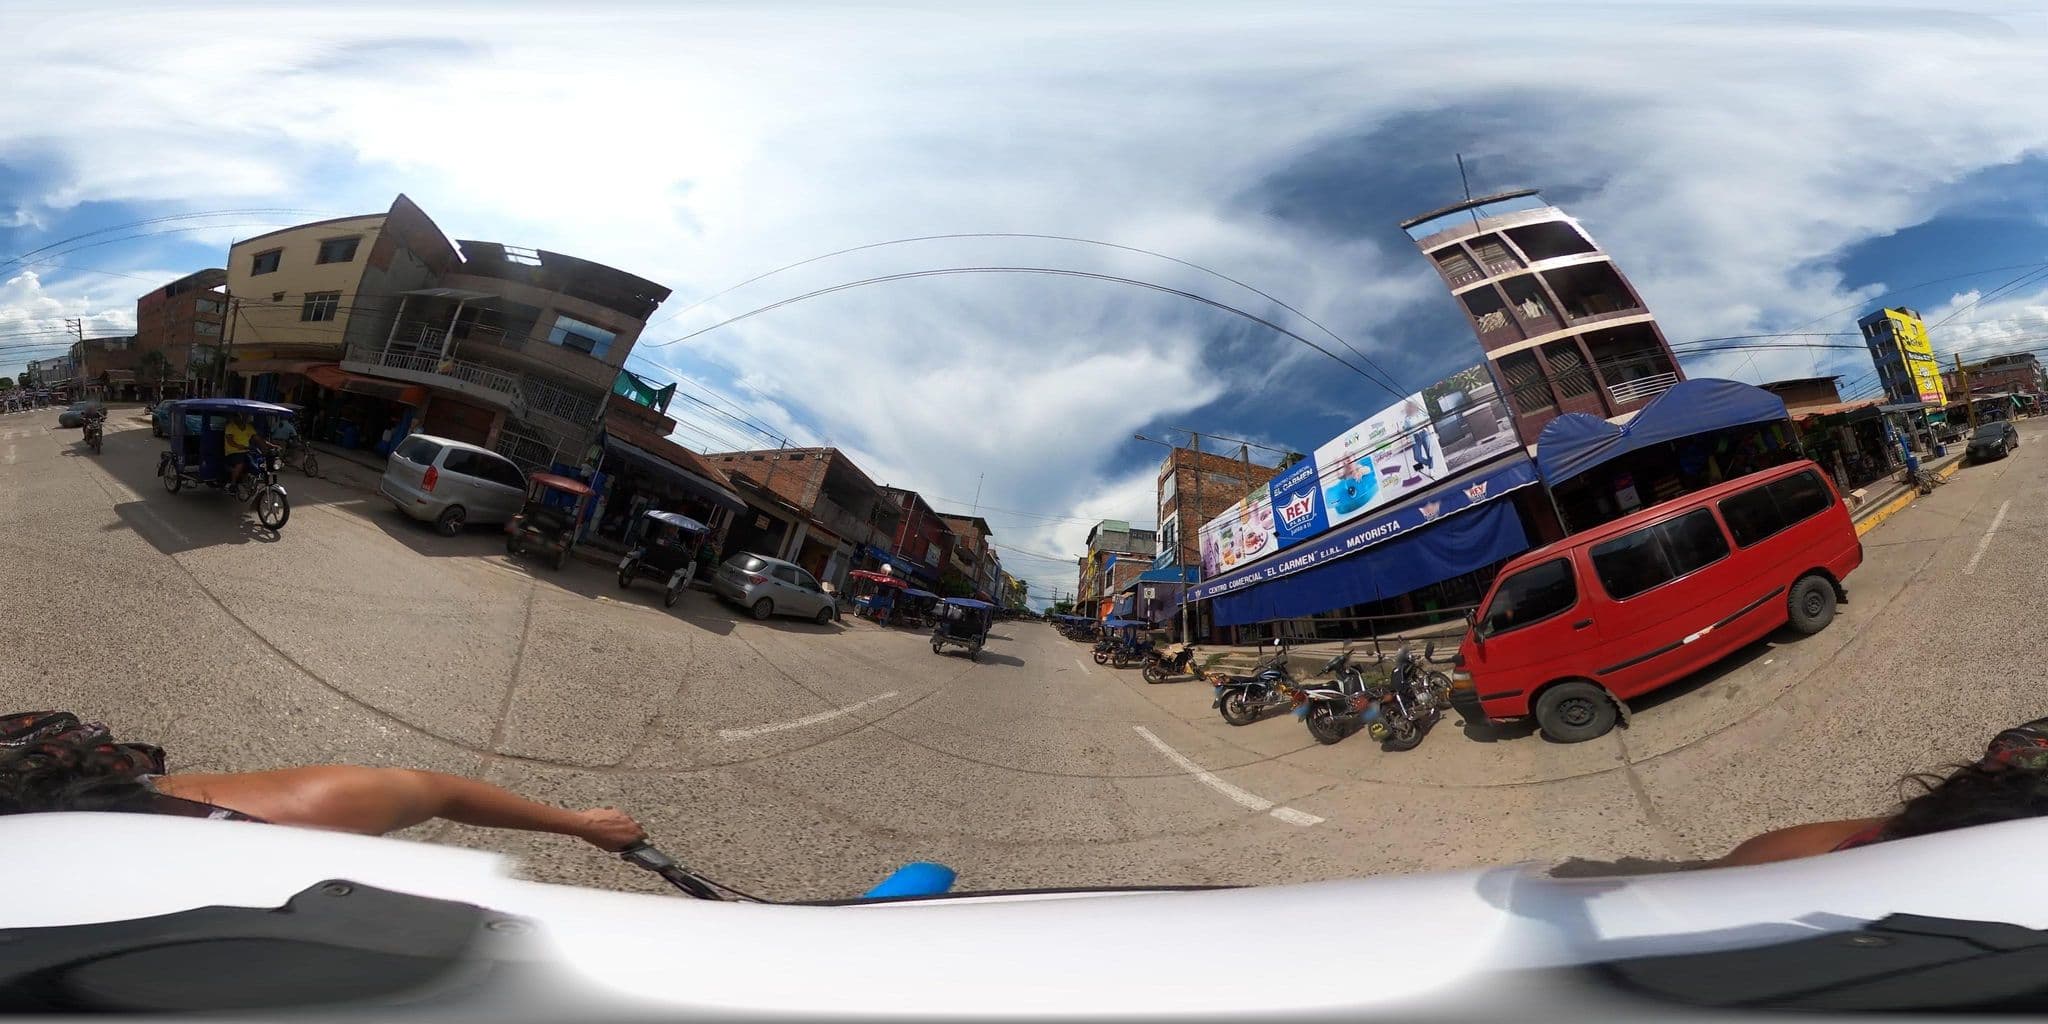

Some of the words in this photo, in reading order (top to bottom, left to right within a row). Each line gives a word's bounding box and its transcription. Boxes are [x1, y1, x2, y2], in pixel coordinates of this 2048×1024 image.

[1273, 487, 1283, 497] EL
[1282, 468, 1313, 491] CARMEN
[1285, 498, 1310, 521] REY
[1289, 514, 1310, 527] PLAST
[1208, 583, 1228, 594] CENTRO
[1229, 572, 1263, 589] COMERCIAL
[1346, 520, 1400, 548] MAYORISTA
